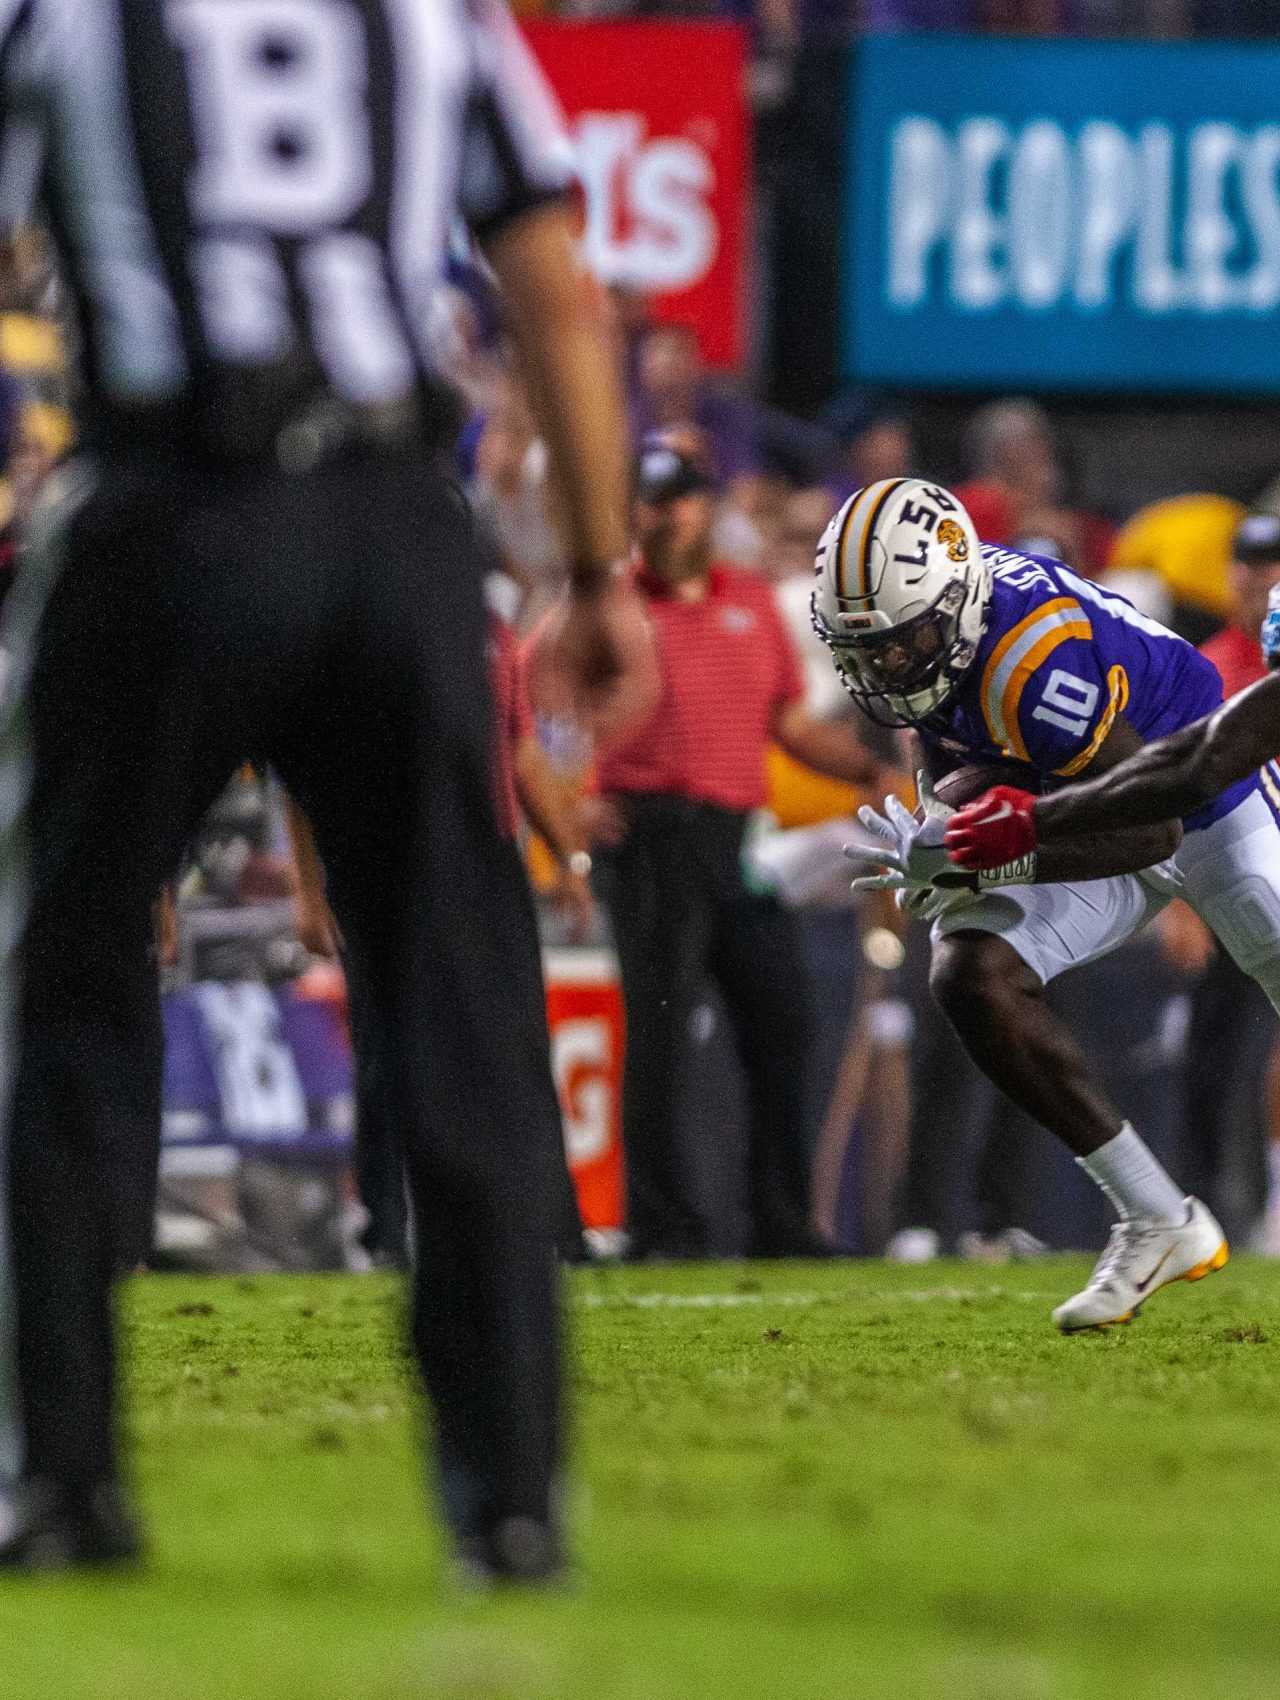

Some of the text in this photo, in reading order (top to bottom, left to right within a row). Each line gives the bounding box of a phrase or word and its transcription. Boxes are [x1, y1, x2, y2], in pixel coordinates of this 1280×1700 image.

[190, 0, 370, 224] B
[1033, 669, 1099, 737] 10
[552, 1016, 613, 1166] G
